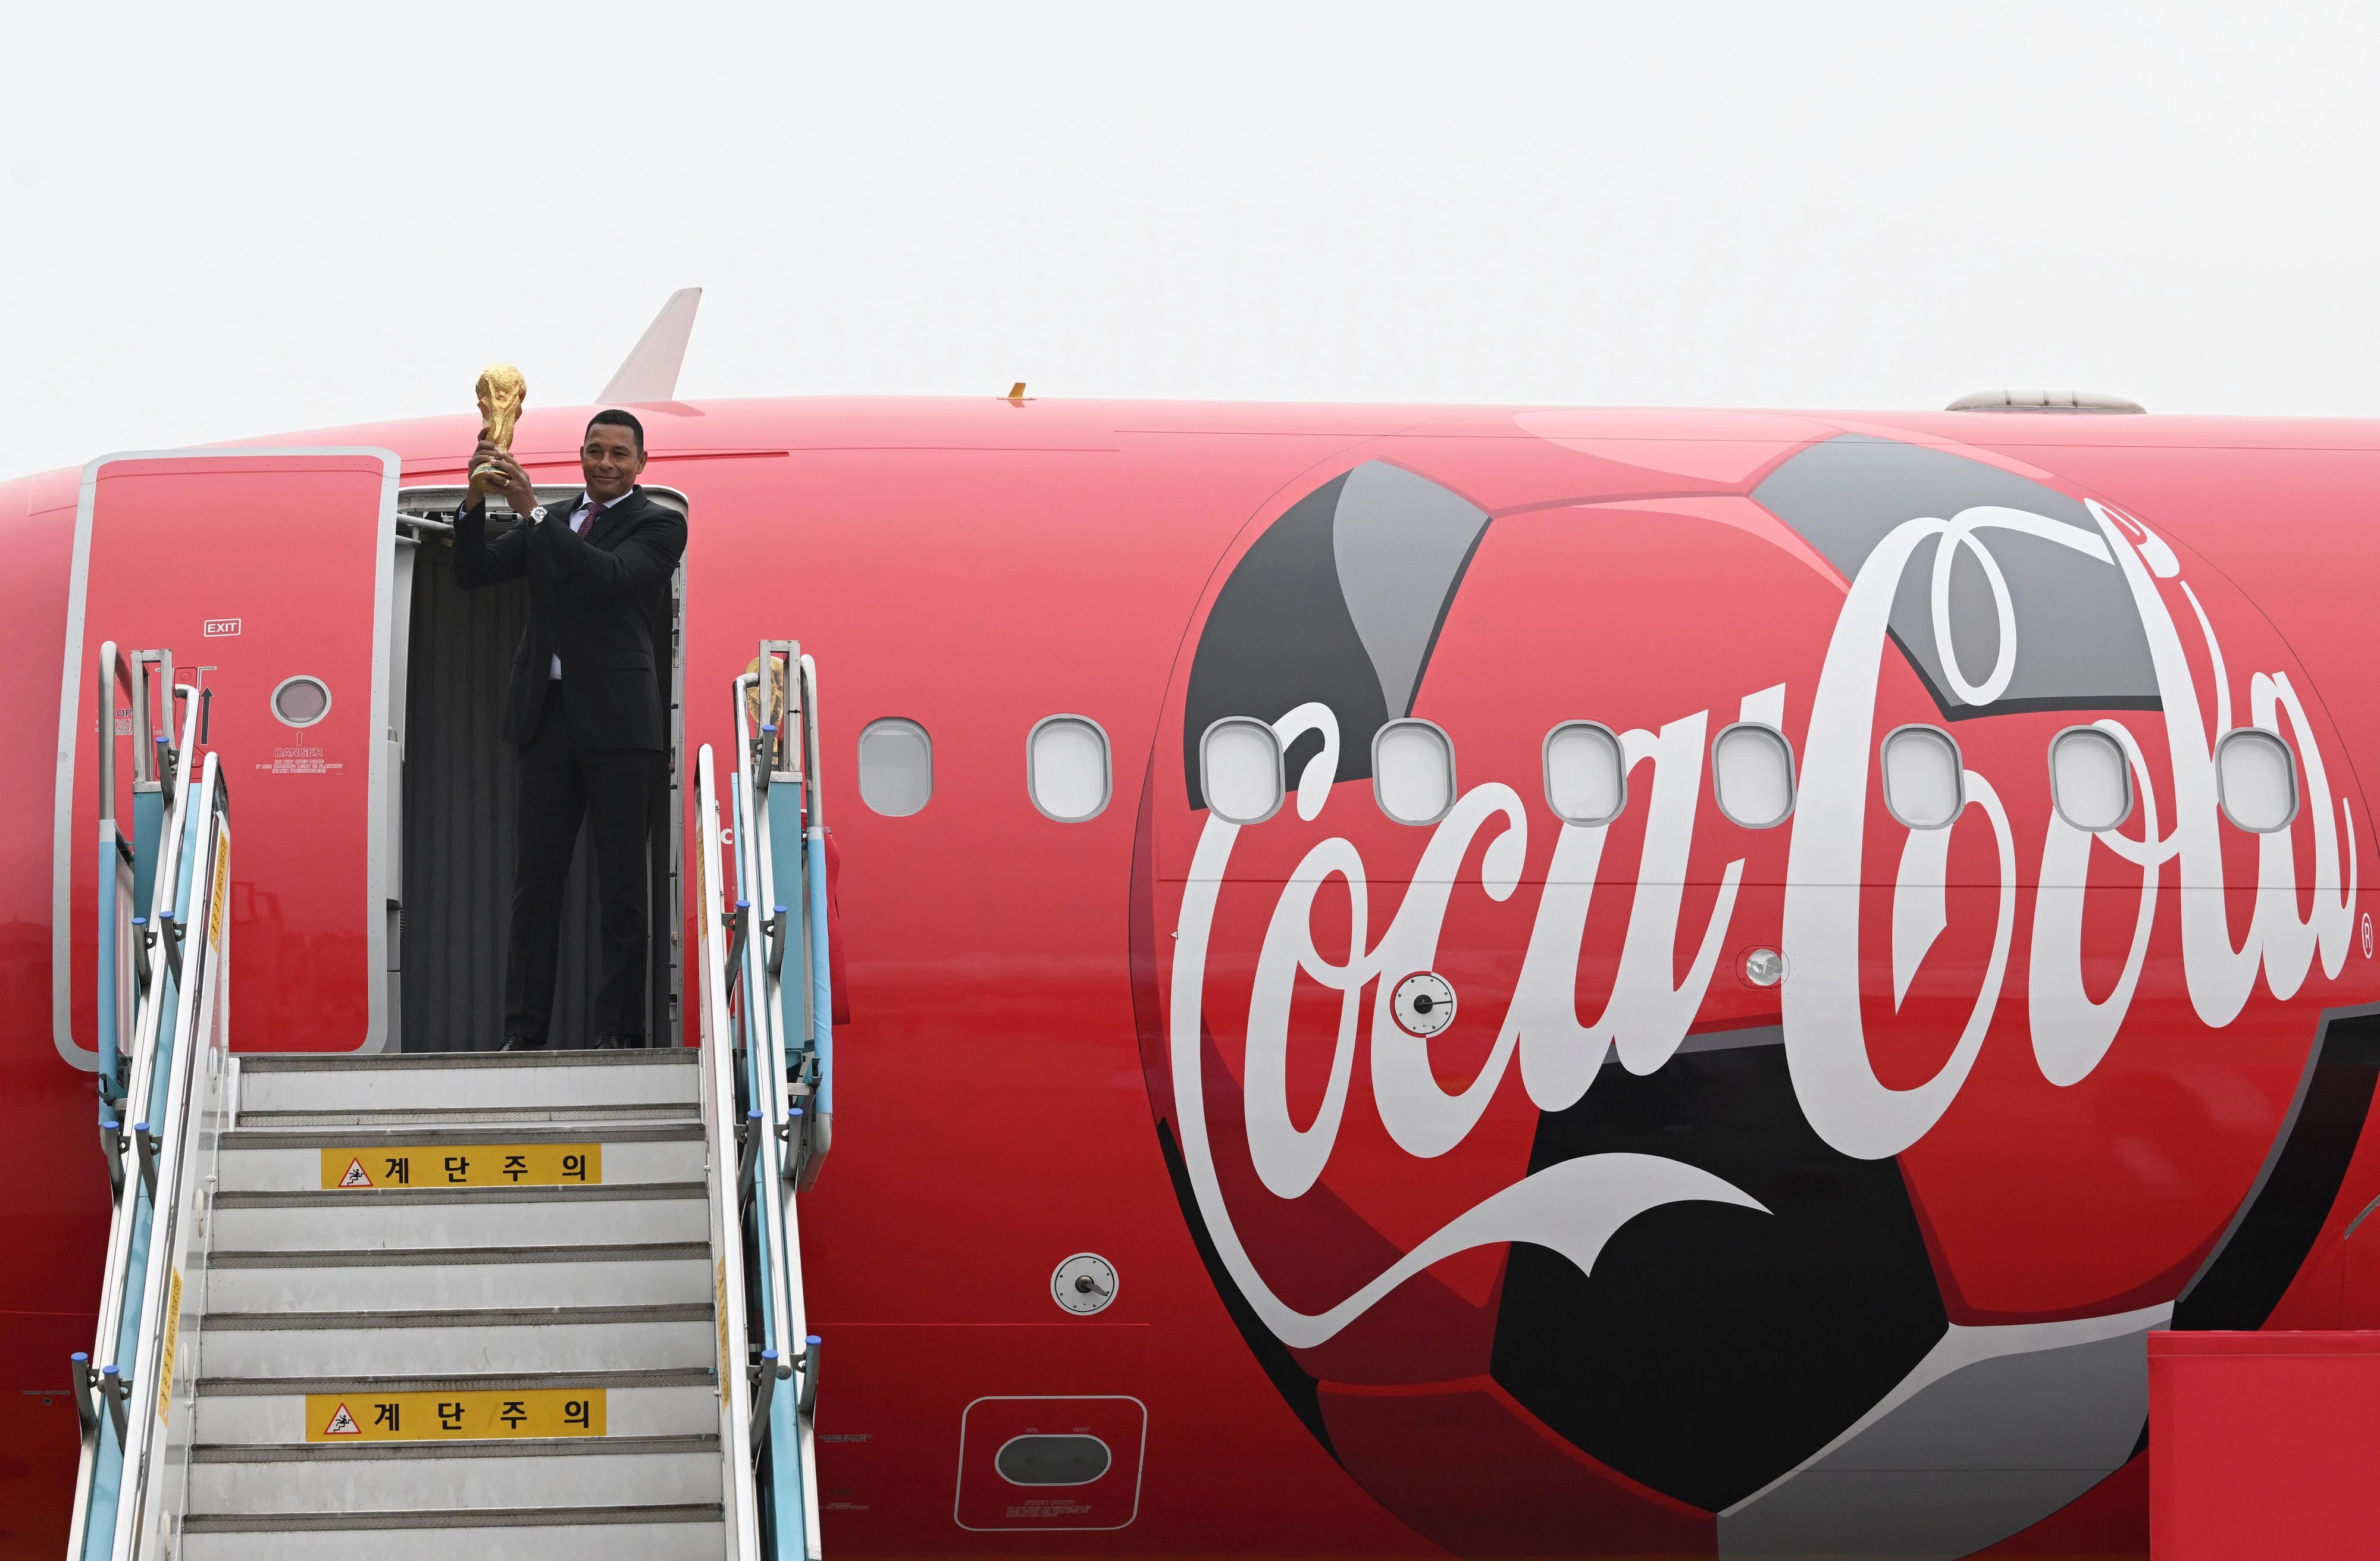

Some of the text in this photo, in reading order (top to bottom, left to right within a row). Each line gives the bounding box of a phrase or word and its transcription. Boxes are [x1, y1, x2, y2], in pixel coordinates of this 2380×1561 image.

[208, 623, 237, 632] EXIT
[117, 709, 133, 717] OP
[275, 747, 323, 757] DANGER
